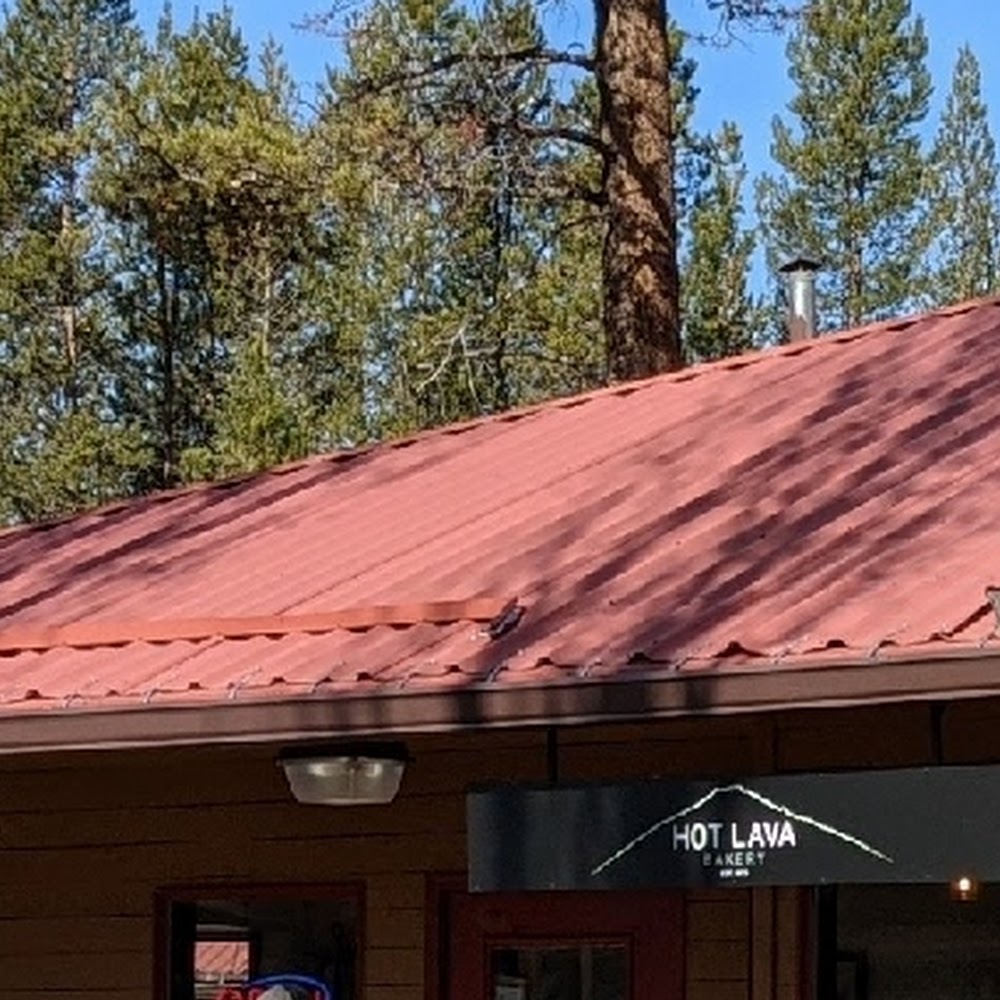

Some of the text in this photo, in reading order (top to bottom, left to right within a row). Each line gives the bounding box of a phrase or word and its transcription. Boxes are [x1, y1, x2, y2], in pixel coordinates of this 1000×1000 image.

[672, 820, 797, 851] HOT LAVA
[703, 851, 766, 867] BAKERY
